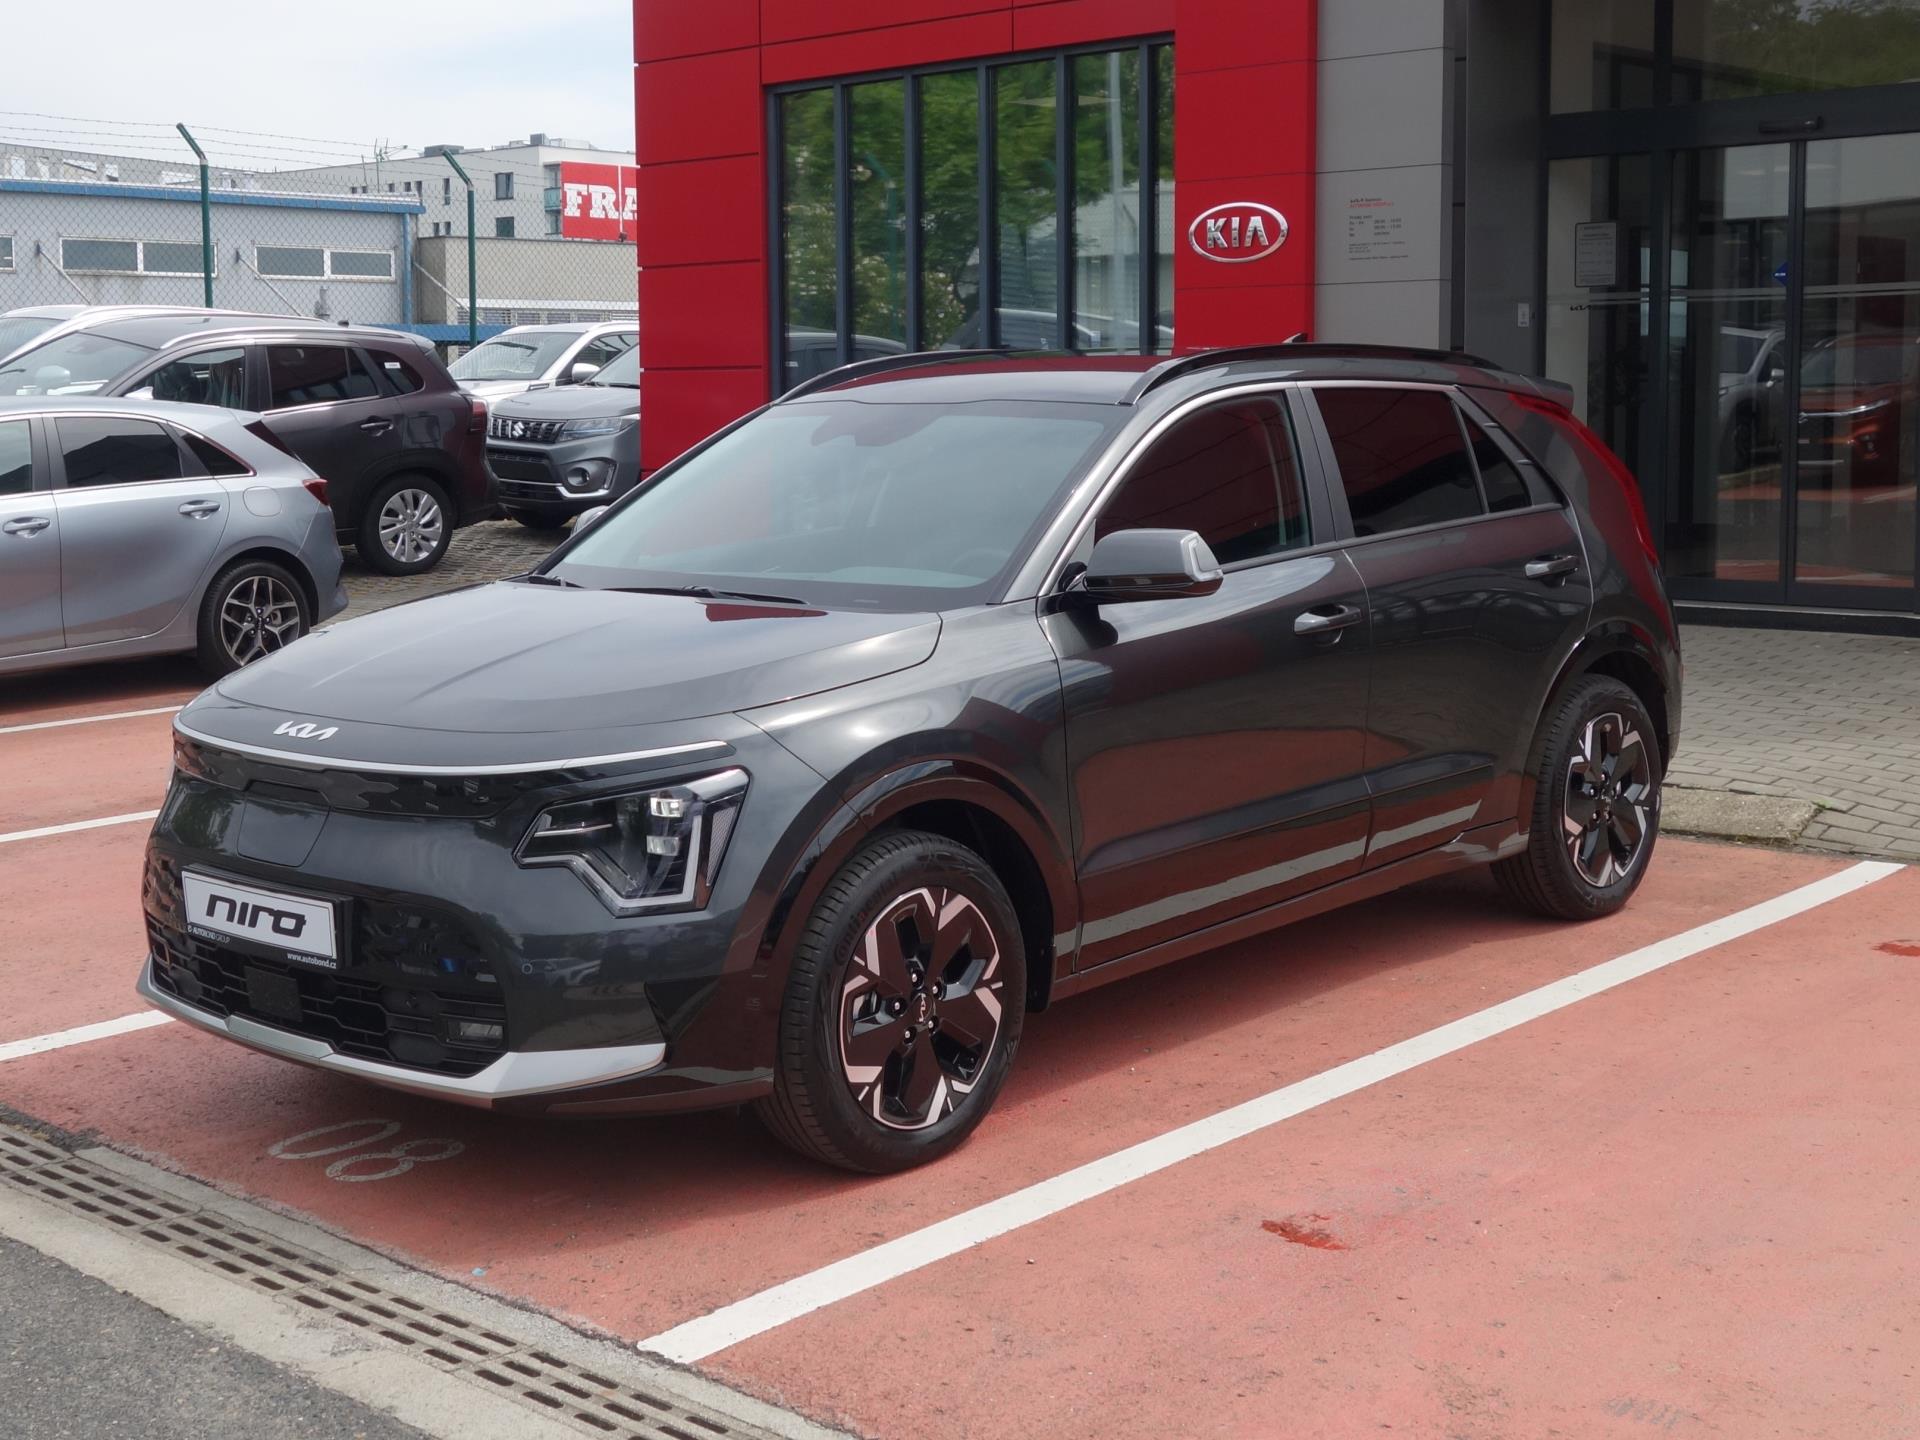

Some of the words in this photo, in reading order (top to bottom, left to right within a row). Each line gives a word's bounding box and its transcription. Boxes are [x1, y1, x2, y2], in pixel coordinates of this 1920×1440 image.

[563, 183, 637, 220] FRA
[1206, 216, 1269, 249] KIA
[206, 893, 308, 938] niro
[287, 952, 337, 970] www.autobond.cz
